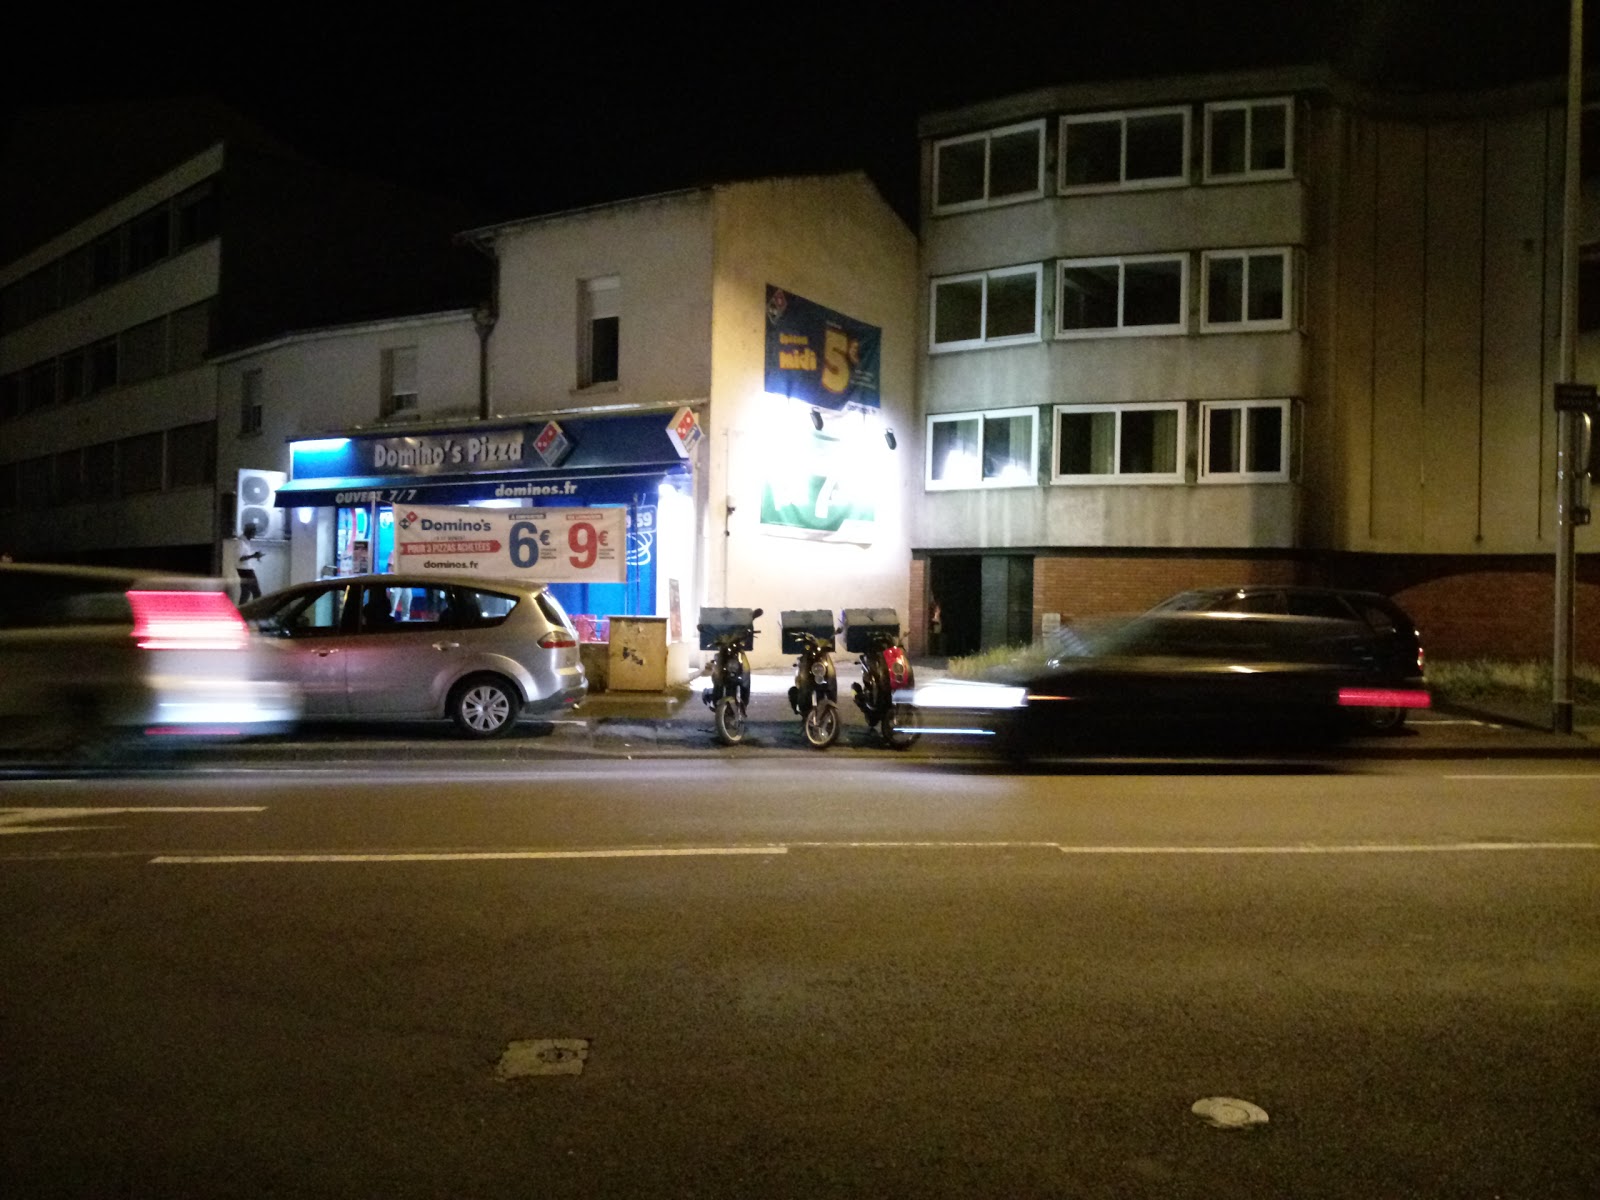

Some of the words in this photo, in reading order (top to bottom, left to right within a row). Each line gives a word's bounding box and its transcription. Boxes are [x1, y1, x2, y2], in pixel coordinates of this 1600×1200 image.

[374, 440, 463, 468] Domino's
[468, 436, 523, 463] Pizza
[495, 481, 578, 497] dominos.fr
[421, 518, 491, 531] Domino's
[433, 543, 456, 553] PIZZAS
[424, 560, 478, 569] dominos.fr
